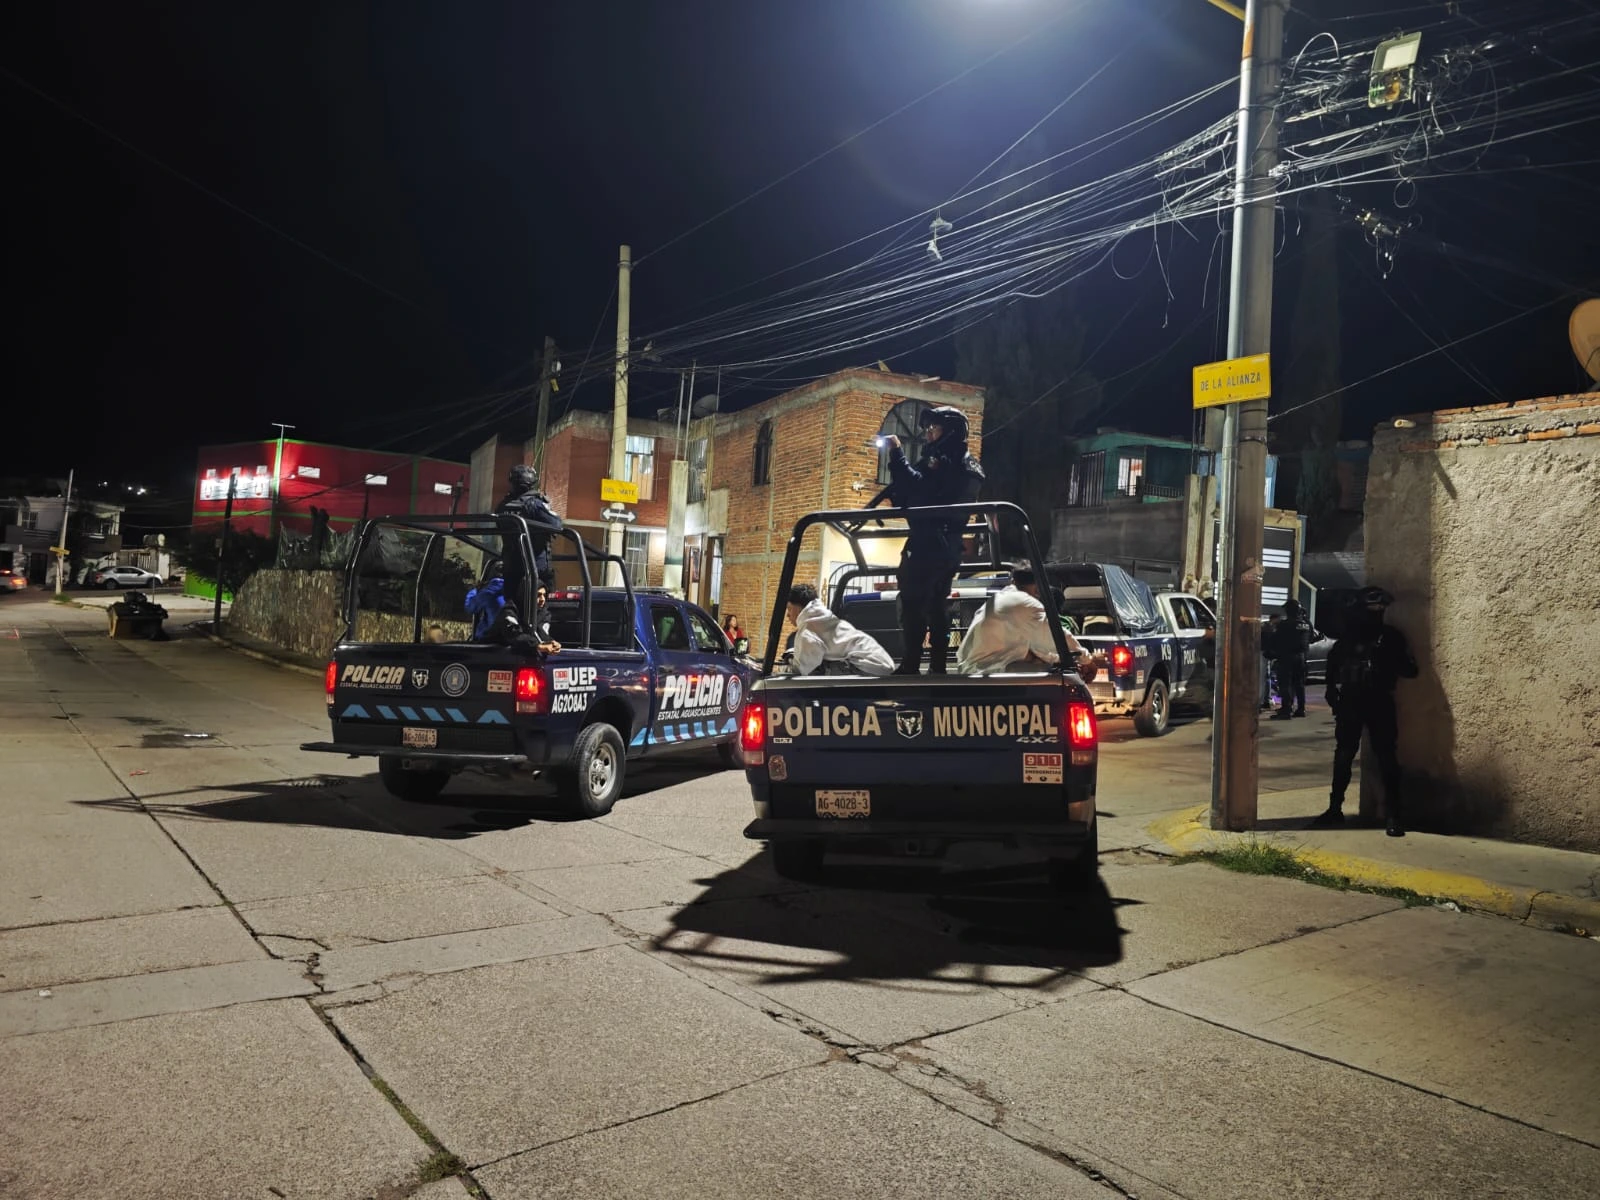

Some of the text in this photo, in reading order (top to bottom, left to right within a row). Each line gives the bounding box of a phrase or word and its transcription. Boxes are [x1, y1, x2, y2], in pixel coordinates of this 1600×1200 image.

[1200, 372, 1262, 391] DE LA ALIANZA
[1161, 643, 1172, 661] K9
[341, 664, 405, 684] POLICIA
[568, 666, 597, 686] UEP
[661, 674, 724, 710] POLICIA
[657, 706, 722, 720] ESTATAL AGUASCALIENTES
[933, 704, 1058, 737] MUNICIPAL
[1027, 756, 1059, 765] 911
